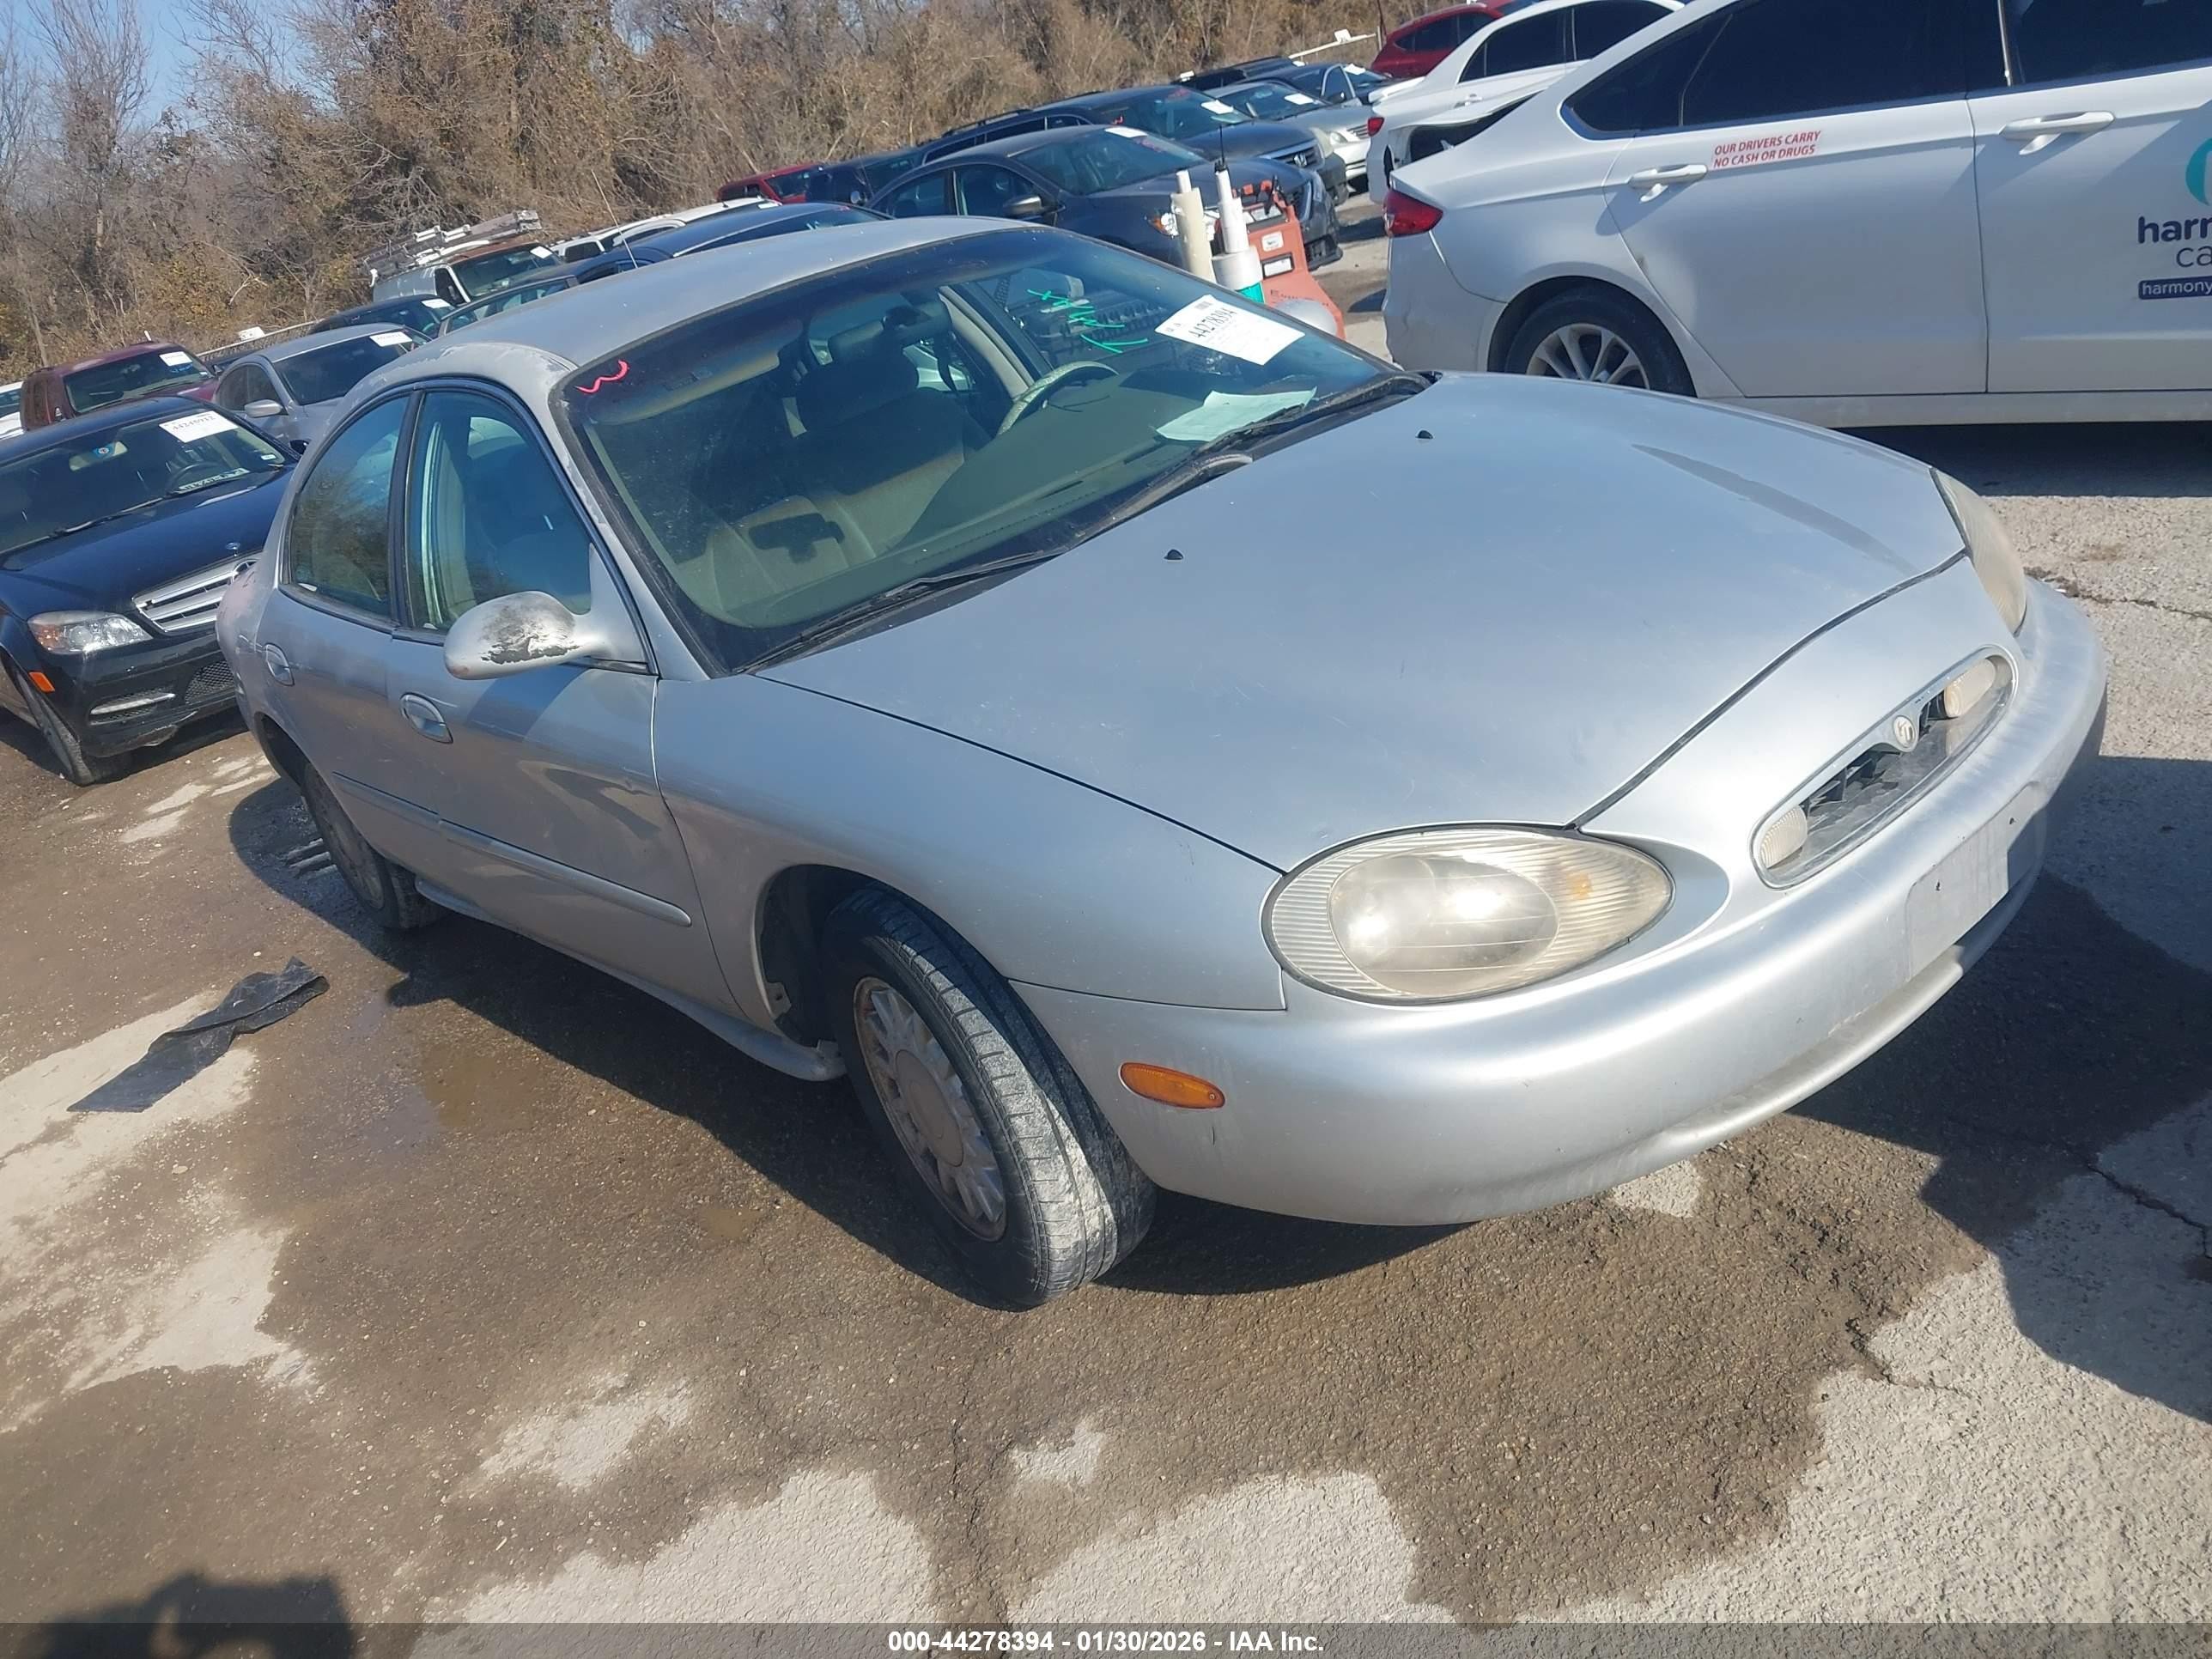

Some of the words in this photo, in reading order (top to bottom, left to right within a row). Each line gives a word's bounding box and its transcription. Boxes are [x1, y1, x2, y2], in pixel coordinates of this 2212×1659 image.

[1714, 143, 1736, 155] OUR
[1738, 136, 1783, 152] DRIVERS
[1784, 131, 1821, 145] CARRY
[1713, 157, 1729, 168] NO
[1731, 154, 1759, 166] CASH
[1761, 149, 1776, 161] OR
[1778, 144, 1816, 159] DRUGS
[1188, 307, 1238, 339] 44278394
